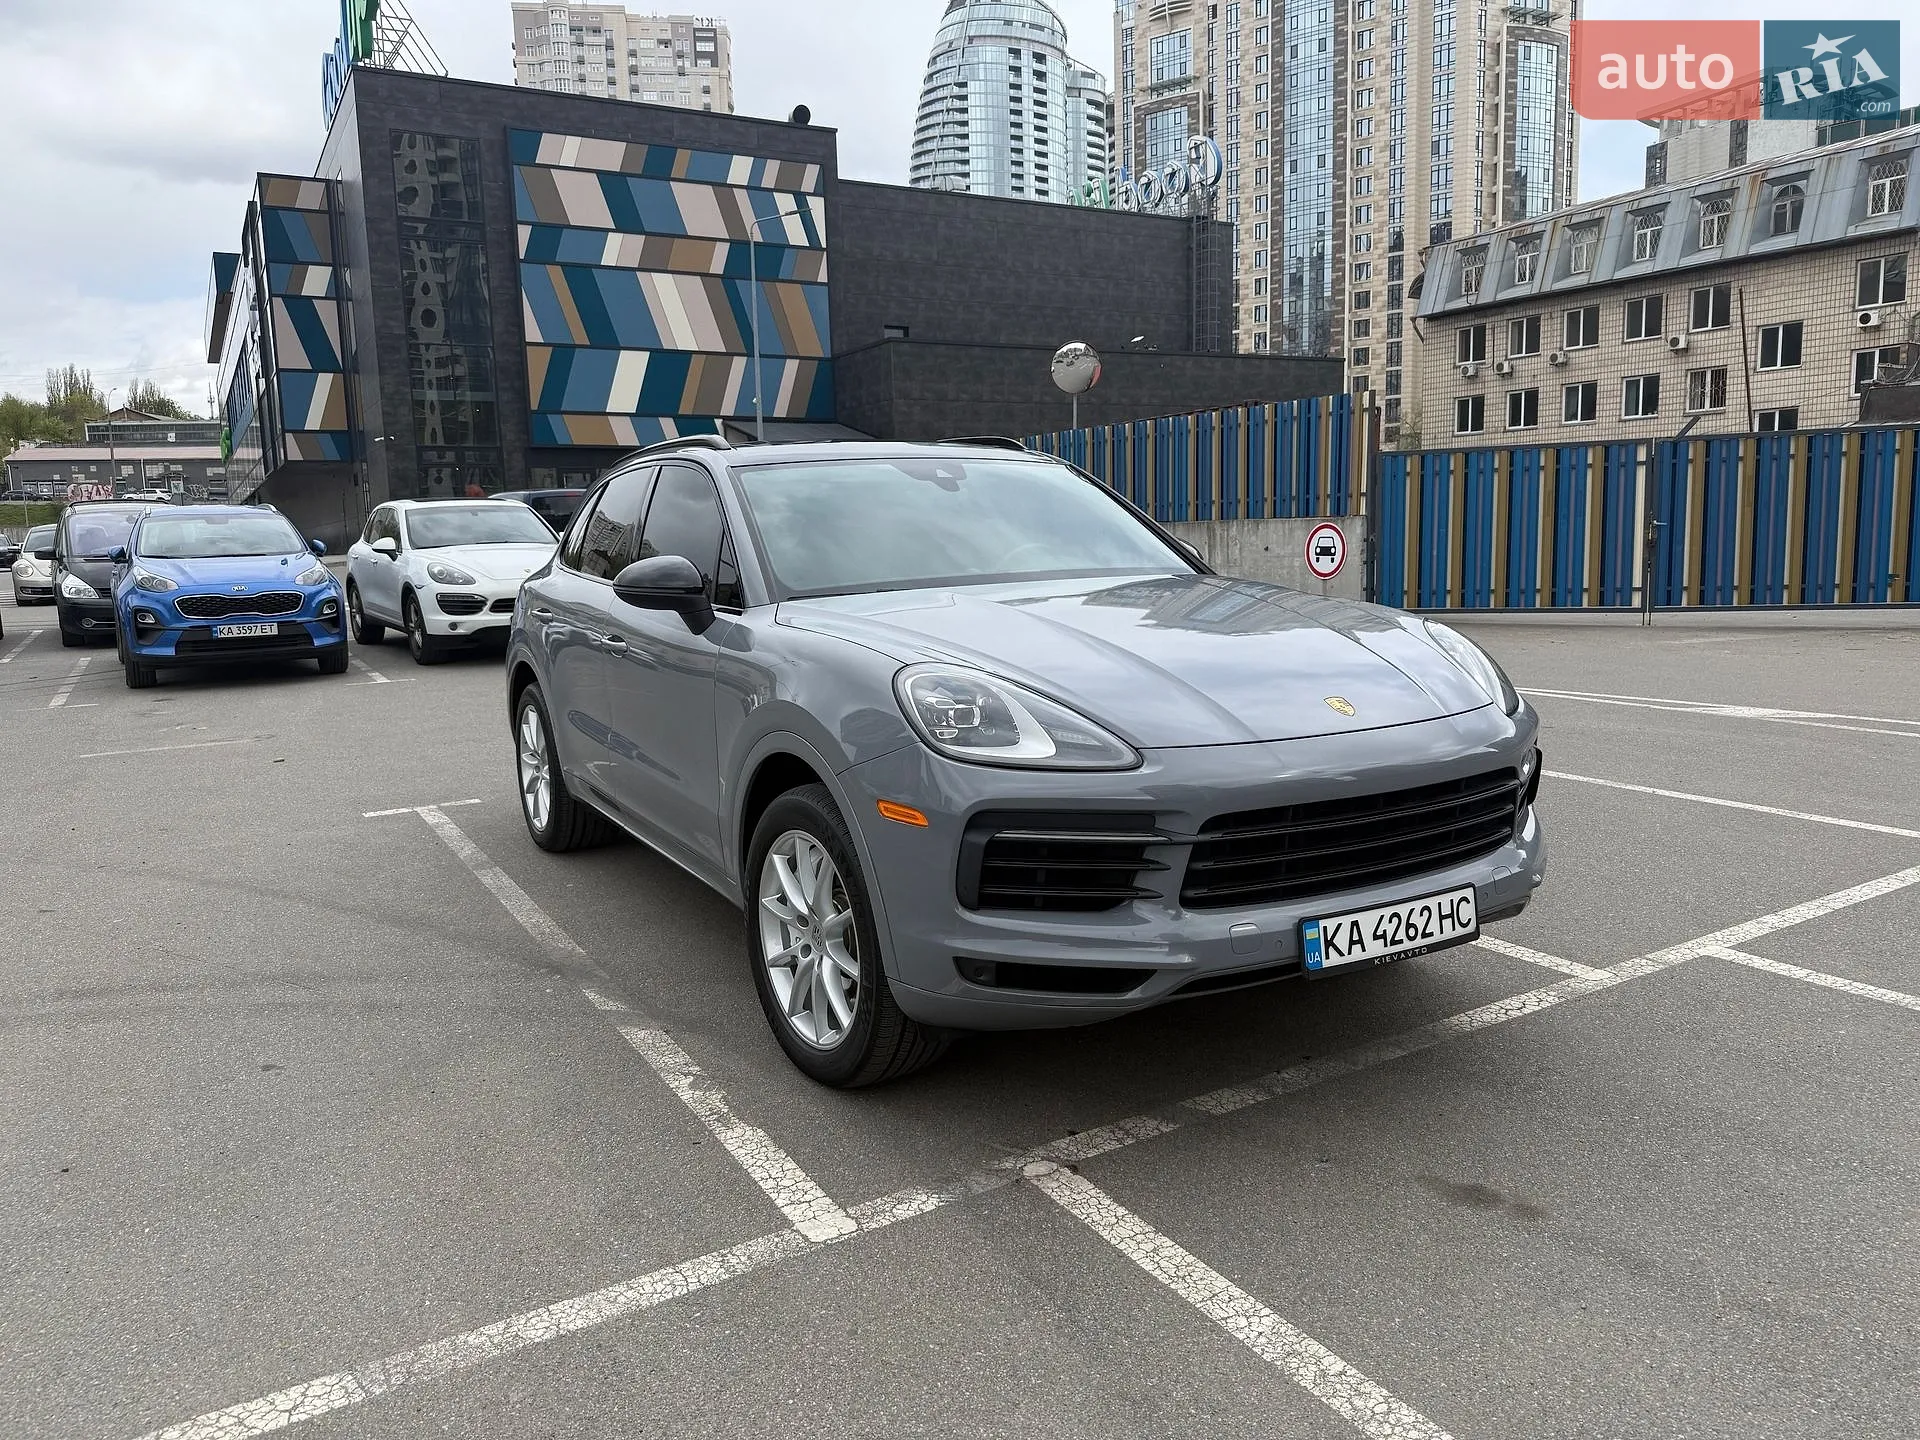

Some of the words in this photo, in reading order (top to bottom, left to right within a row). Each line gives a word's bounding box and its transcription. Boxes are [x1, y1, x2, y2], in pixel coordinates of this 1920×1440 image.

[219, 626, 234, 636] KA
[236, 625, 258, 635] 3597
[260, 624, 274, 633] ET
[1307, 951, 1321, 964] UA
[1323, 919, 1366, 960] KA
[1372, 905, 1434, 948] 4262
[1437, 896, 1472, 934] HC
[1374, 946, 1428, 965] KIEVAVTO
